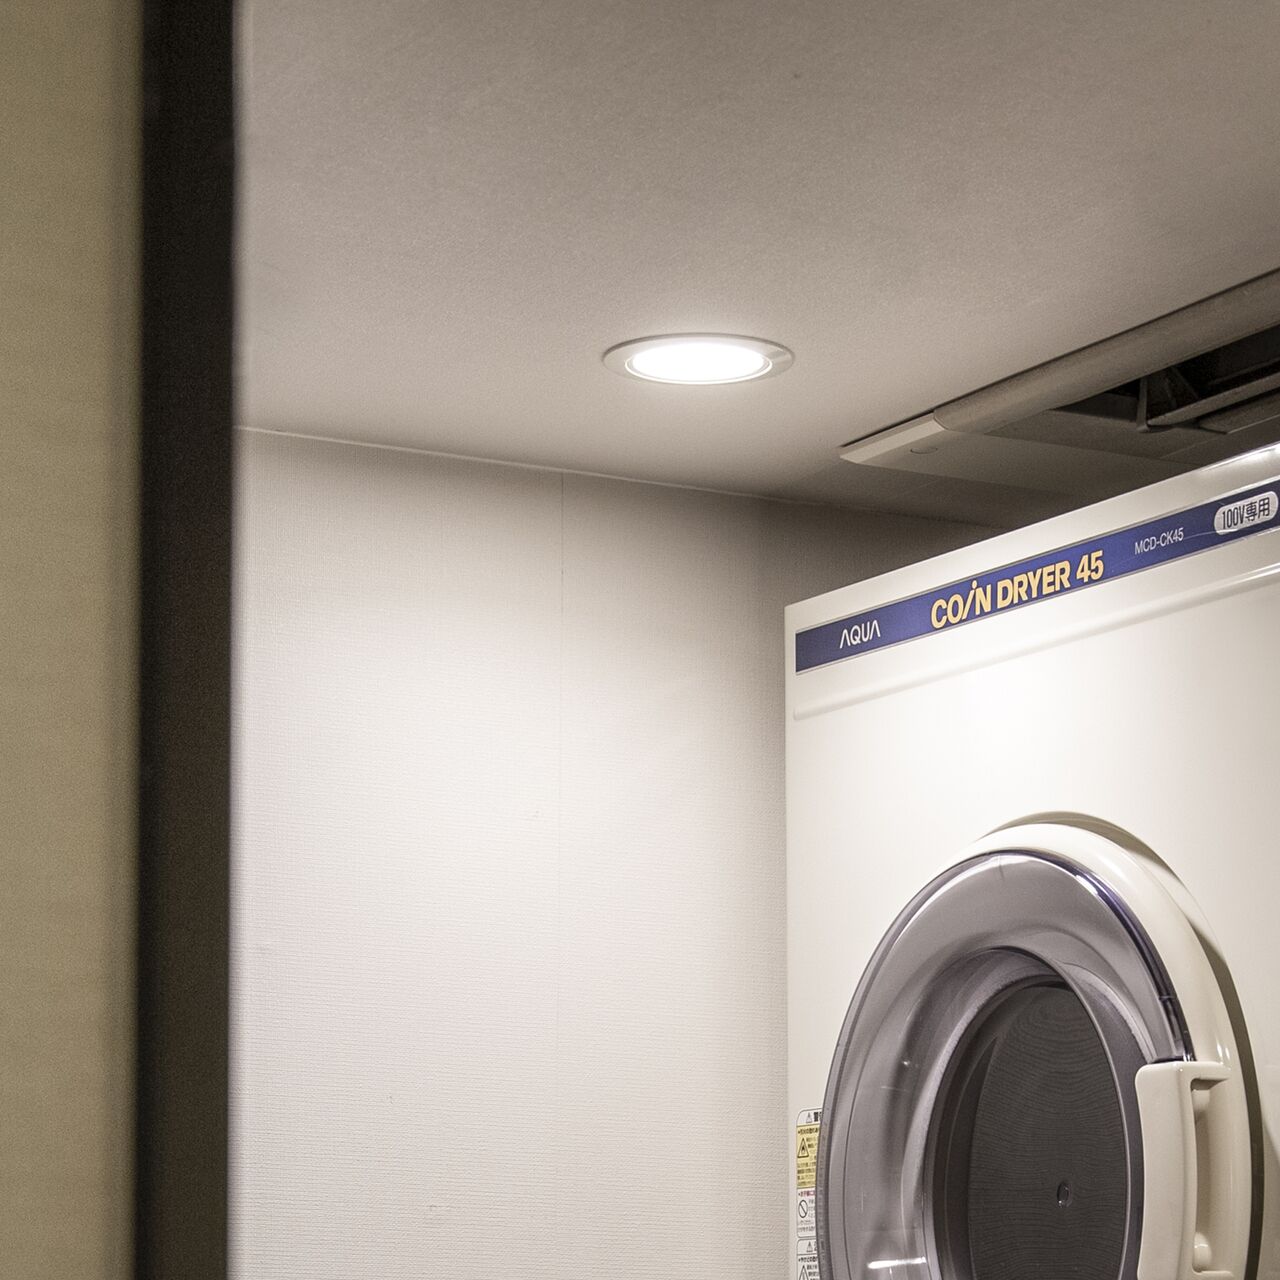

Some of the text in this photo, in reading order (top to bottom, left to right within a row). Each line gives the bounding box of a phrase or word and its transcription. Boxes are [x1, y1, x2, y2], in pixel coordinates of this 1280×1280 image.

[1134, 527, 1185, 556] MCD-CK45
[996, 562, 1072, 609] DRYER
[1076, 550, 1104, 585] 45
[839, 619, 881, 650] AQUA
